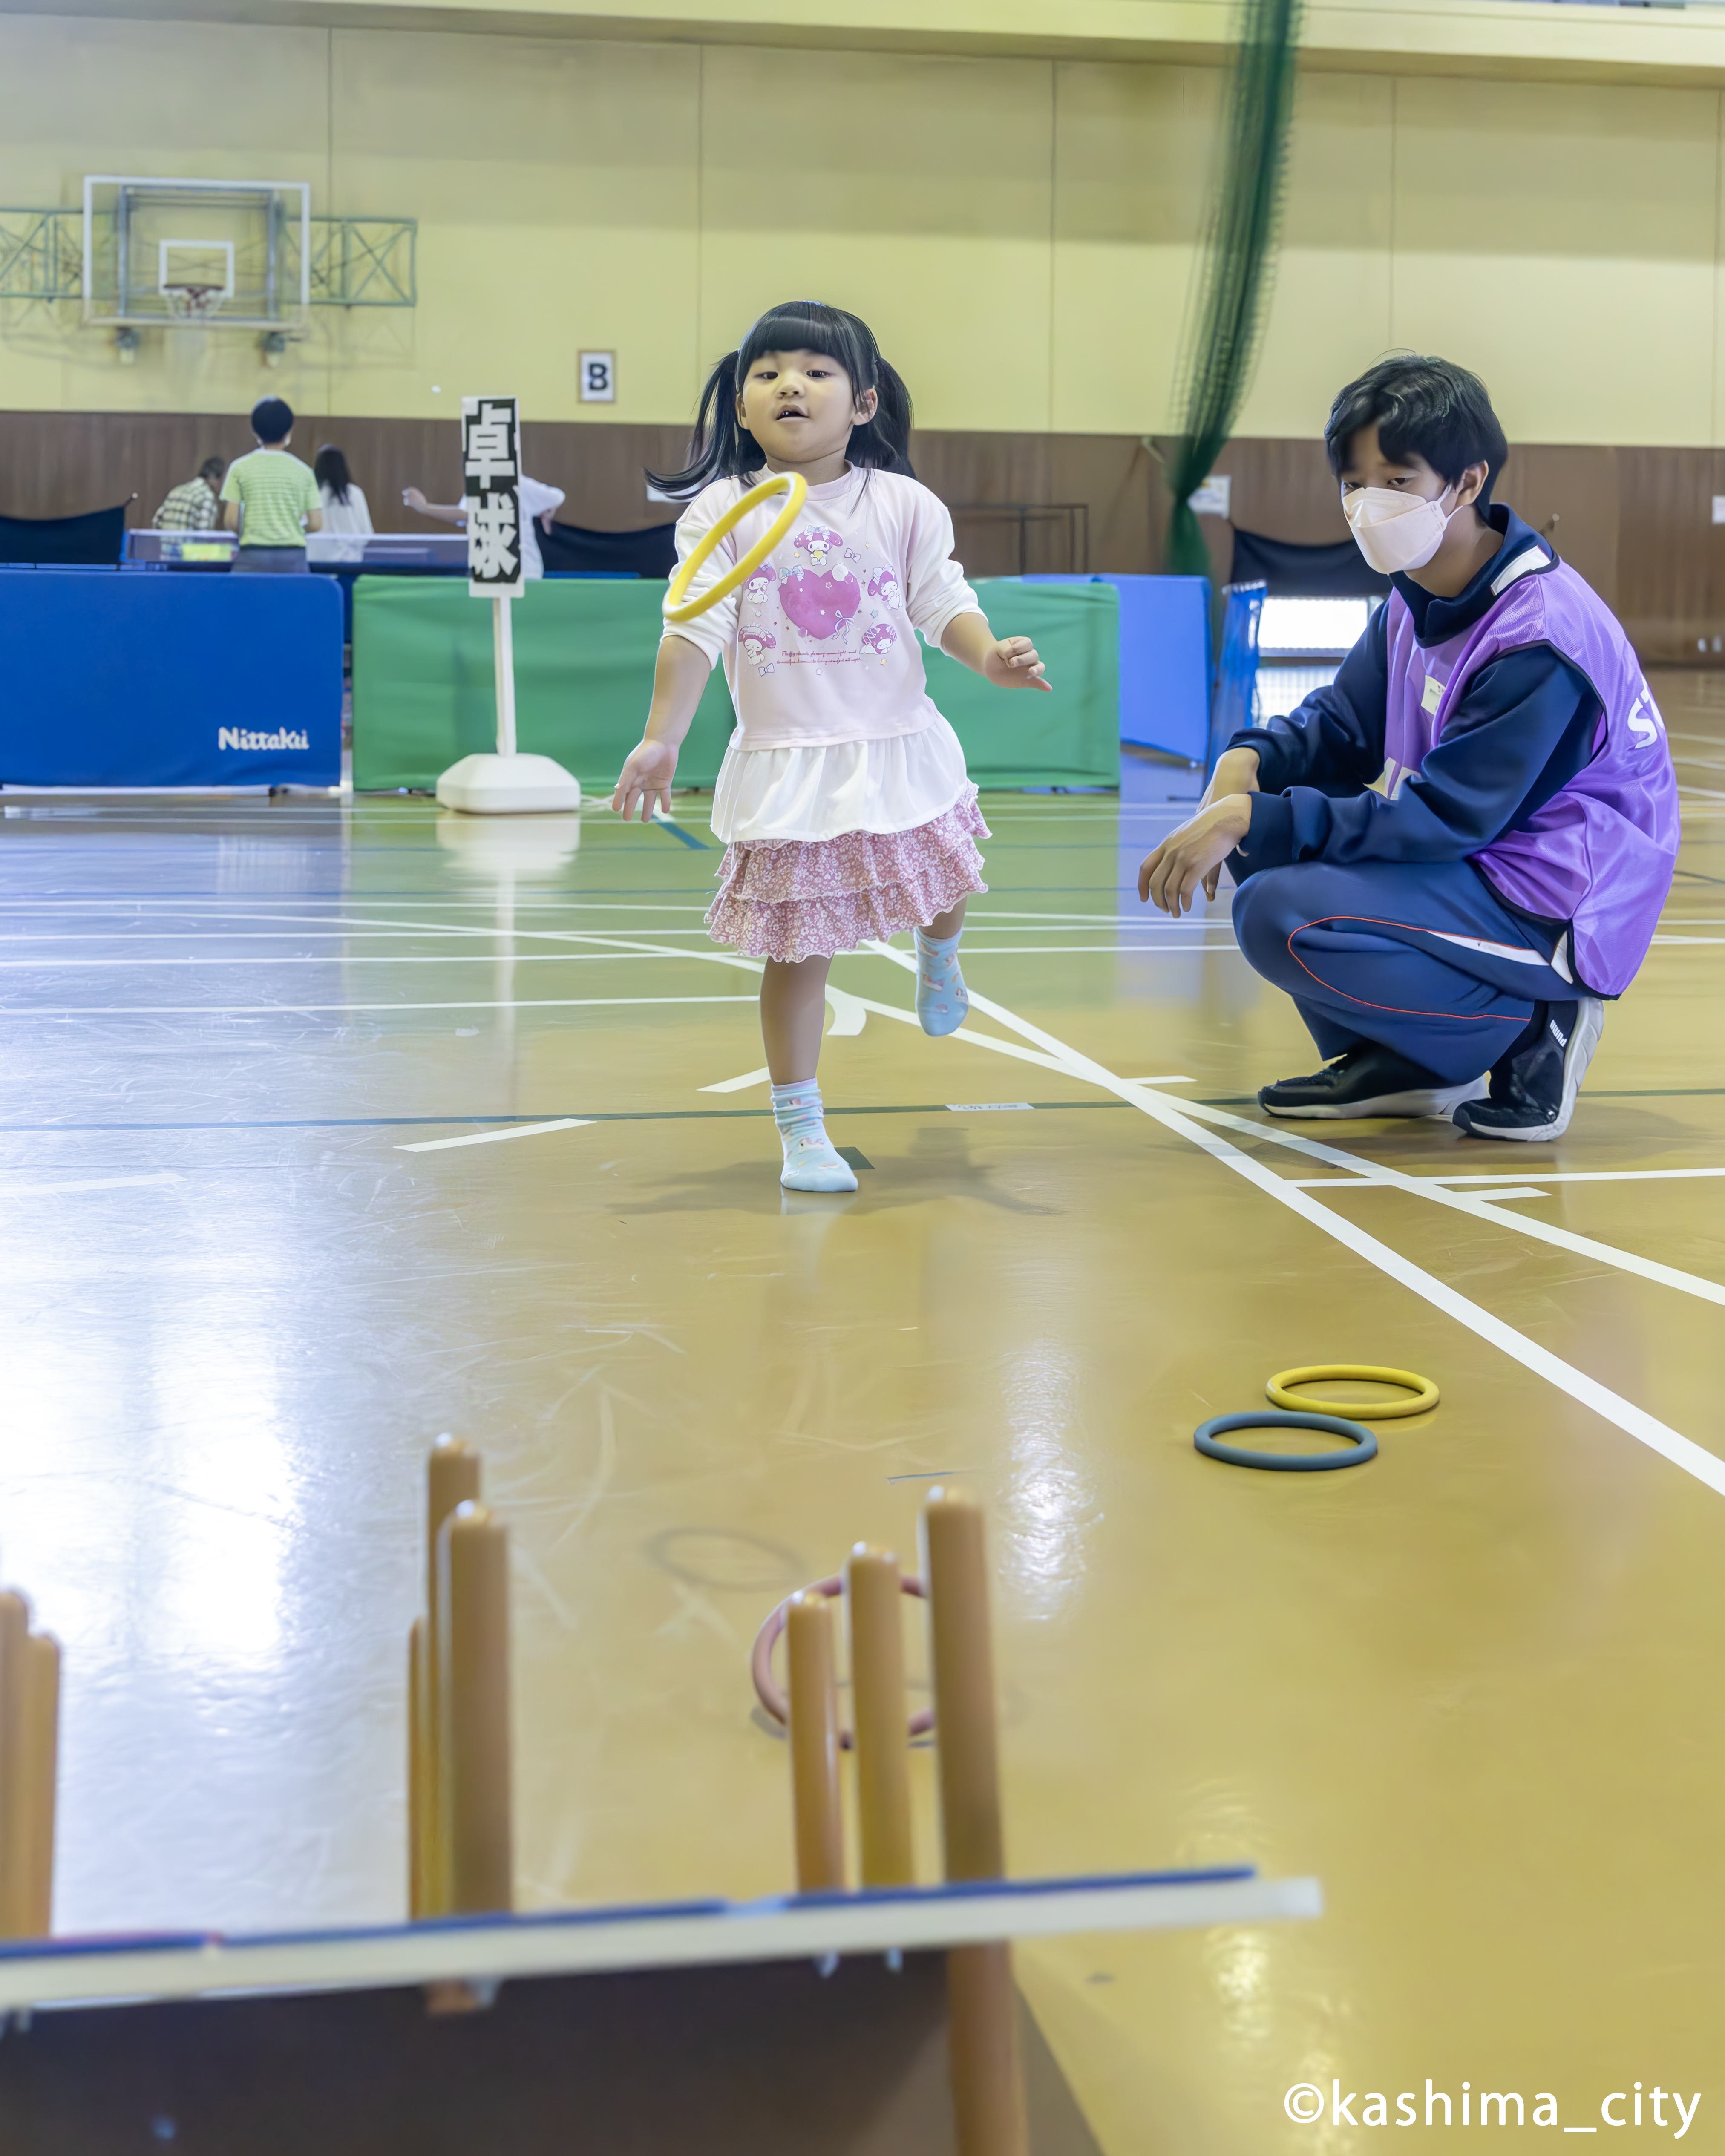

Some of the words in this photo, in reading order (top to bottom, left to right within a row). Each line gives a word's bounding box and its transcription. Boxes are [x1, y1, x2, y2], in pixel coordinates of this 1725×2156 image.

[589, 363, 608, 390] B
[465, 403, 518, 579] 卓球
[218, 726, 310, 750] Nittaku
